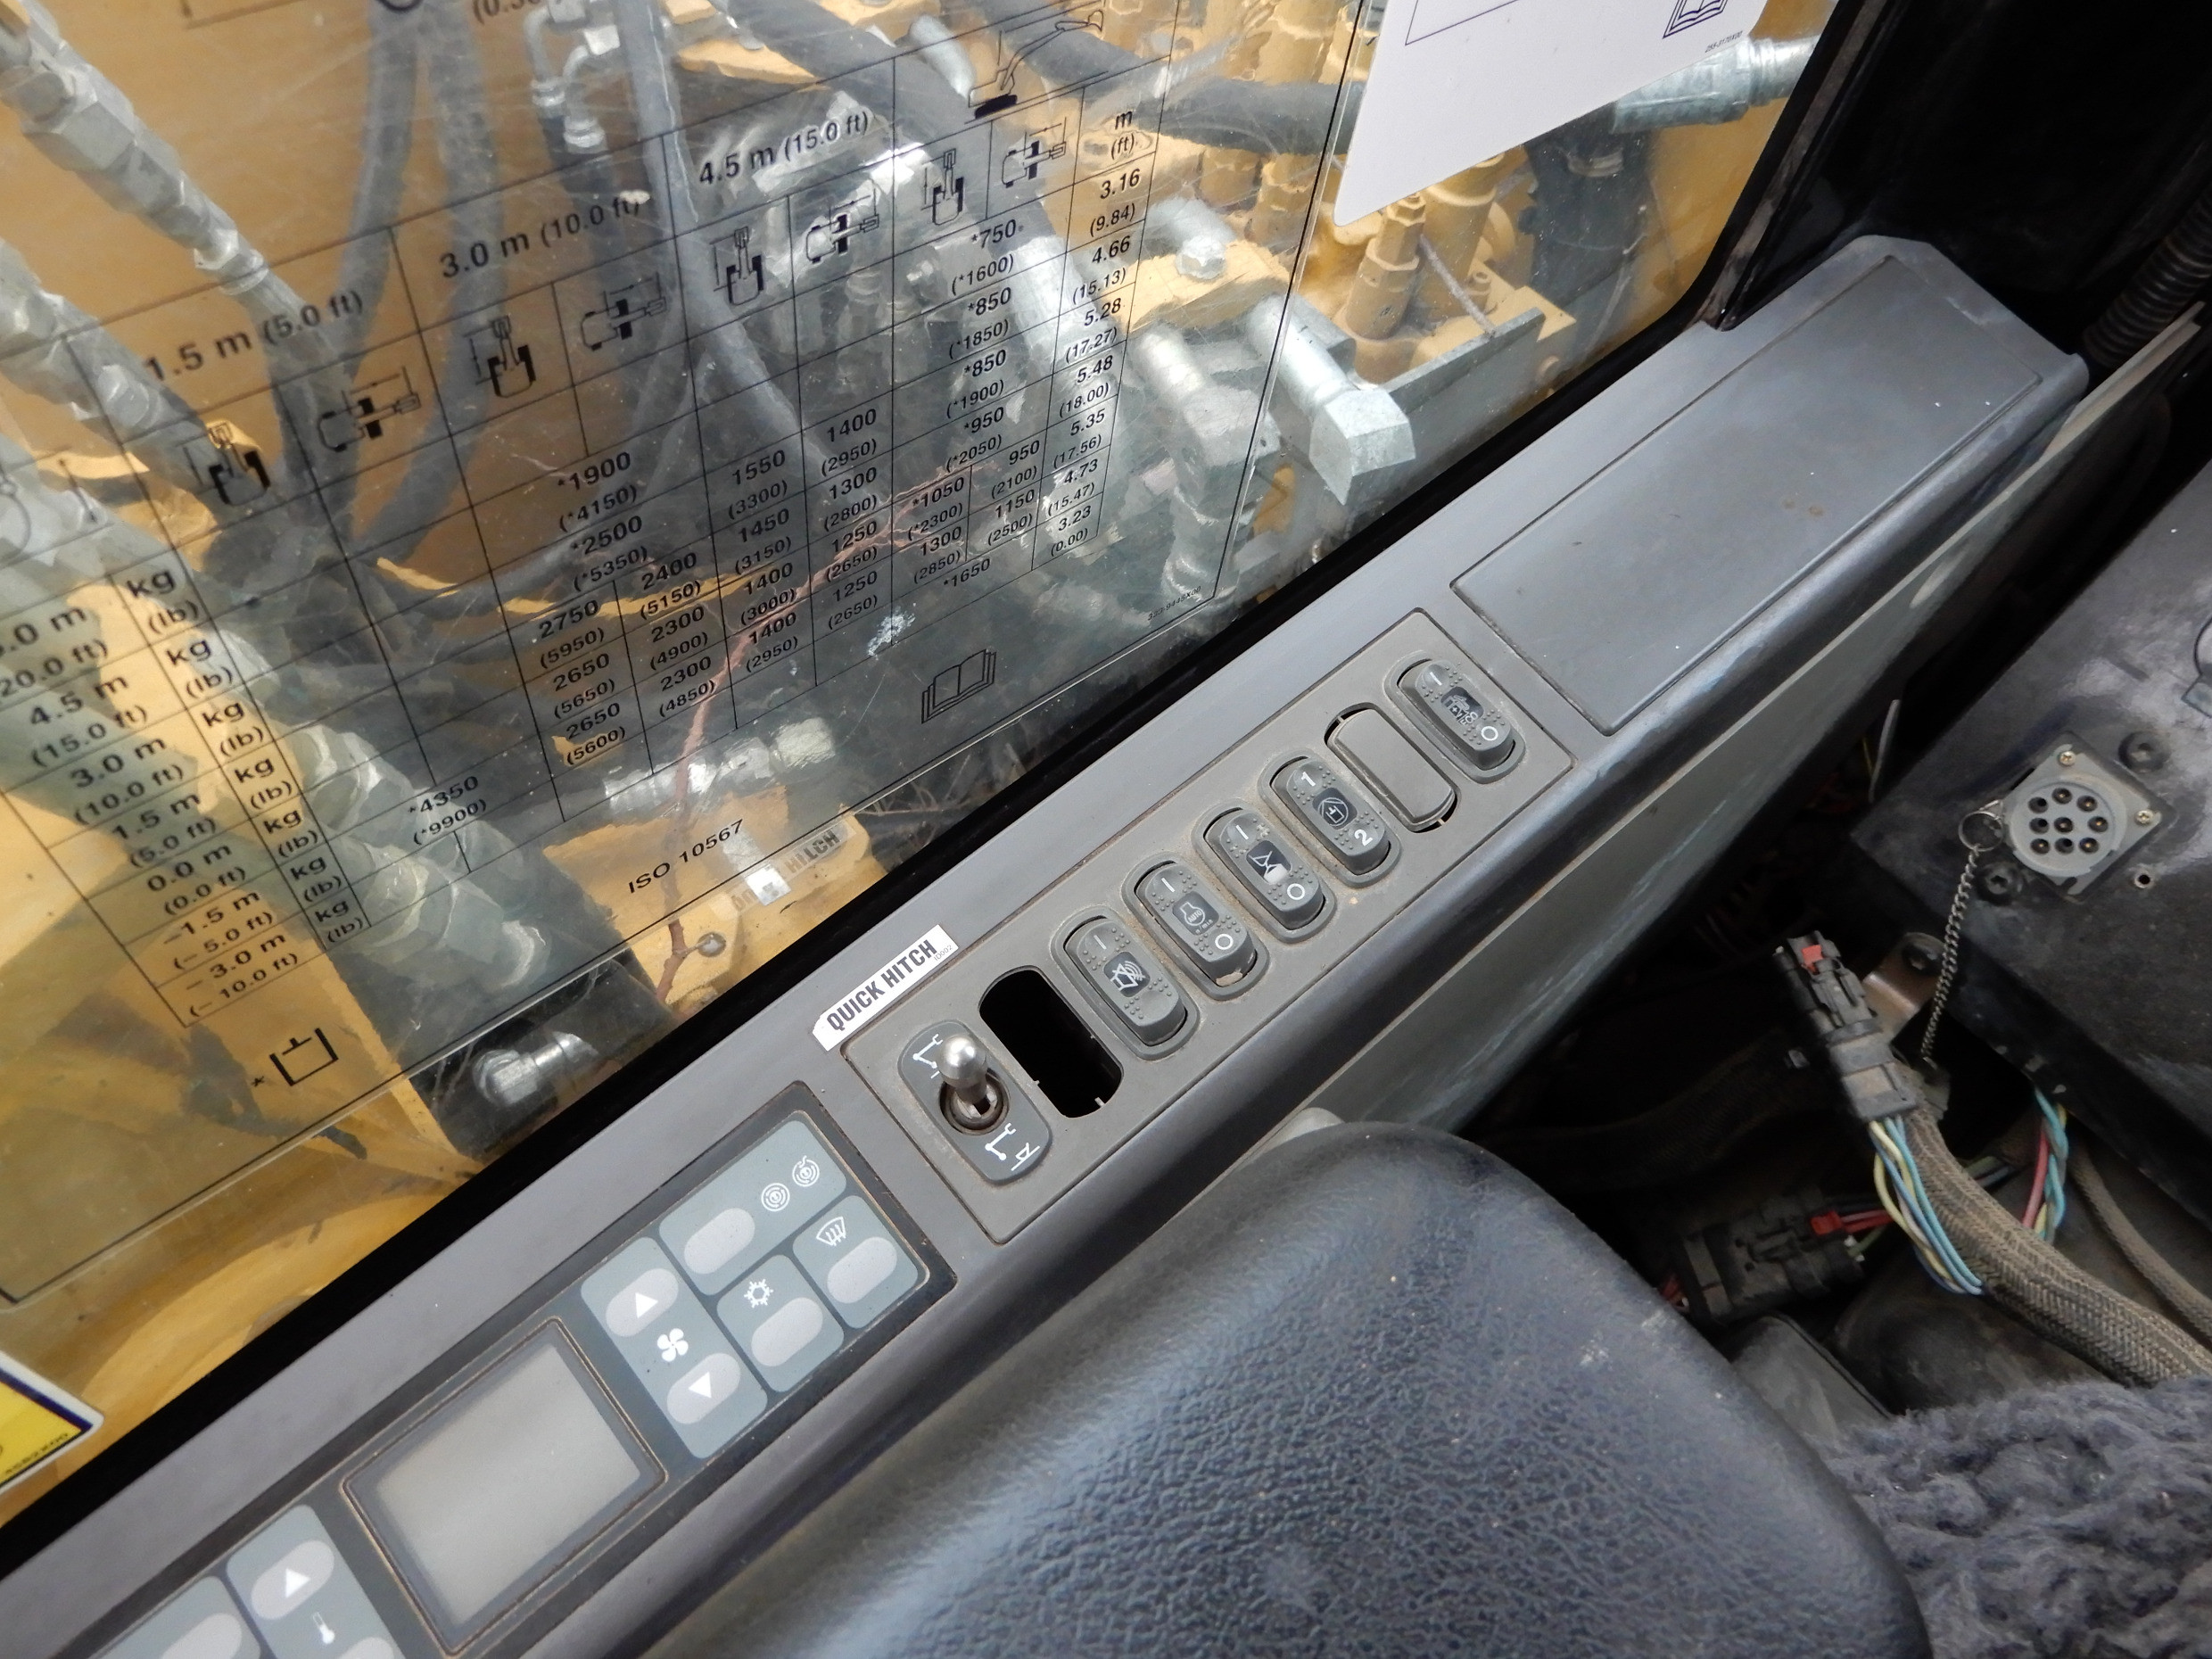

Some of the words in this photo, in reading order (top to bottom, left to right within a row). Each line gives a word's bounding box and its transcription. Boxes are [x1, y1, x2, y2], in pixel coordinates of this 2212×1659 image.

[1115, 111, 1132, 129] m
[699, 155, 740, 186] 4.5
[750, 145, 776, 169] m
[785, 122, 841, 163] (15.0
[847, 111, 869, 135] ft)
[1111, 134, 1135, 160] (ft)
[1101, 168, 1140, 200] 3.16
[1090, 203, 1135, 237] (9.84)
[440, 243, 489, 279] 3.0
[501, 229, 531, 254] m
[541, 204, 605, 247] (10.0
[1092, 235, 1131, 264] 4.66
[1073, 268, 1126, 305] (15.13)
[1084, 298, 1121, 326] 5.28
[144, 343, 204, 382] 1.5
[215, 332, 252, 359] m
[263, 304, 320, 344] (5.0
[329, 289, 363, 319] ft)
[1066, 327, 1117, 364] (17.27)
[1077, 355, 1113, 383] 5.48
[1060, 383, 1109, 418] (18.00)
[827, 409, 876, 442] 1400
[1070, 409, 1105, 436] 5.35
[732, 450, 786, 485] 1550
[821, 438, 876, 476] (2950)
[1009, 441, 1040, 465] 950
[1053, 434, 1102, 469] (17.56)
[830, 466, 877, 499] 1300
[991, 466, 1037, 499] (2100)
[1063, 459, 1098, 485] 4.73
[729, 480, 788, 520] (3300)
[824, 495, 877, 532] (2800)
[995, 489, 1035, 518] 1150
[1048, 483, 1094, 516] (15.47)
[739, 508, 789, 542] 1450
[1059, 506, 1091, 532] 3.23
[831, 521, 877, 552] 1250
[920, 526, 962, 556] 1300
[641, 552, 697, 590] 2400
[735, 536, 791, 575] (3150)
[826, 547, 877, 582] (2650)
[913, 550, 960, 583] (2850)
[127, 569, 175, 598] kg
[744, 562, 793, 595] 1400
[832, 571, 877, 602] 1250
[148, 600, 200, 634] (lb)
[641, 581, 701, 620] (5150)
[740, 588, 796, 625] (3000)
[828, 595, 877, 630] (2650)
[0, 623, 38, 656] .0
[51, 607, 86, 631] m
[539, 599, 598, 639] 2750
[651, 607, 705, 642] 2300
[749, 612, 796, 644] 1400
[72, 639, 107, 663] ft)
[166, 640, 212, 665] kg
[540, 627, 604, 669] (5950)
[650, 631, 707, 670] (4900)
[746, 637, 797, 673] (2950)
[186, 667, 234, 698] (lb)
[553, 653, 609, 691] 2650
[661, 656, 711, 691] 2300
[30, 692, 84, 724] 4.5
[95, 674, 128, 698] m
[202, 702, 244, 727] kg
[554, 679, 615, 719] (5650)
[659, 681, 715, 717] (4850)
[32, 722, 106, 767] (15.0
[115, 706, 147, 729] ft)
[566, 703, 620, 739] 2650
[220, 727, 264, 756] (lb)
[566, 726, 625, 764] (5600)
[71, 755, 124, 788] 3.0
[135, 737, 166, 760] m
[235, 757, 274, 783] kg
[74, 781, 144, 825] (10.0
[153, 765, 184, 785] ft)
[251, 781, 293, 809] (lb)
[111, 810, 161, 839] 1.5
[169, 793, 201, 813] m
[264, 809, 302, 833] kg
[129, 836, 179, 867] (5.0
[187, 818, 217, 838] ft)
[278, 830, 318, 858] (lb)
[1354, 829, 1372, 846] 2
[148, 861, 194, 891] 0.0
[203, 844, 233, 865] m
[290, 856, 326, 879] kg
[628, 863, 671, 894] ISO
[679, 819, 743, 863] 10567
[165, 884, 212, 914] (0.0
[219, 866, 246, 887] ft)
[233, 891, 260, 911] m
[303, 877, 342, 902] (lb)
[247, 912, 273, 931] ft)
[315, 900, 350, 922] kg
[260, 933, 286, 952] m
[327, 919, 363, 942] (lb)
[273, 953, 298, 972] ft)
[827, 981, 885, 1031] QUICK
[880, 939, 937, 987] HITCH
